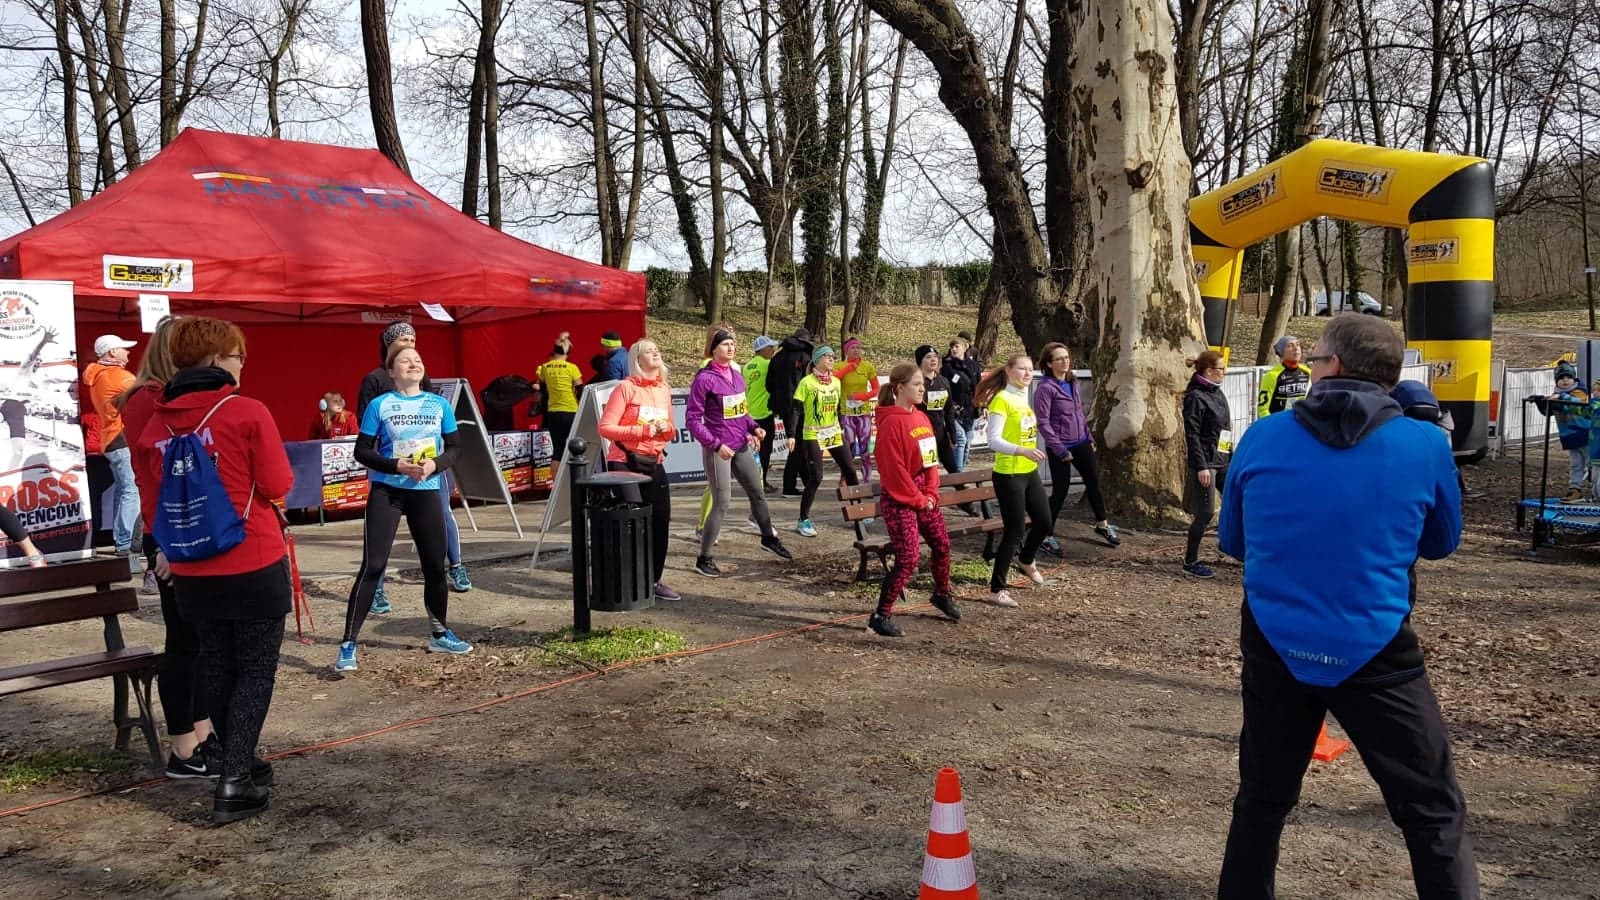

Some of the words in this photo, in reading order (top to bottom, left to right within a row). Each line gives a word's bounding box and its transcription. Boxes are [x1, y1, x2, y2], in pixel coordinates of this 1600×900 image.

[732, 403, 745, 415] 18
[155, 427, 214, 456] TM
[825, 437, 836, 447] 22
[1288, 648, 1349, 666] newline
